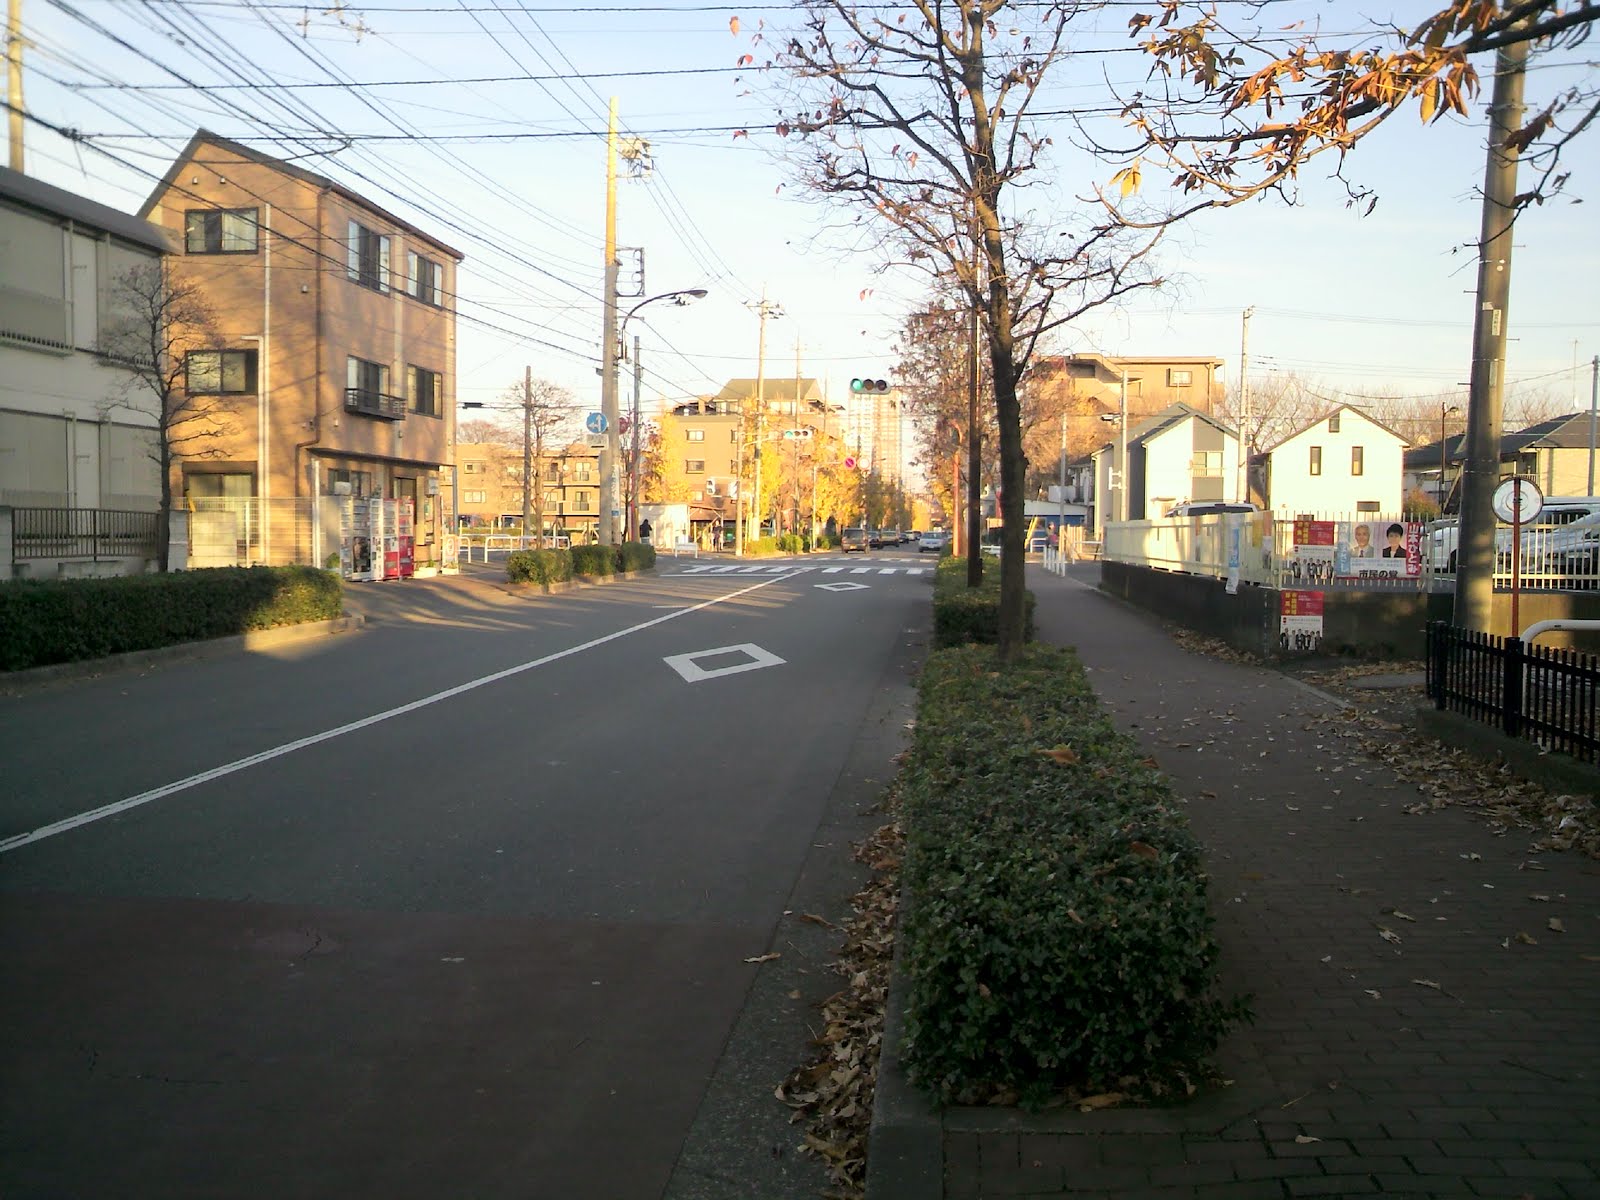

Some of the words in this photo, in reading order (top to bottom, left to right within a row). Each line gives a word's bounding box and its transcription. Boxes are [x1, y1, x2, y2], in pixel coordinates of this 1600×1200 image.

[1407, 524, 1419, 574] 山本ひとみ
[1359, 569, 1398, 579] 市民の党
